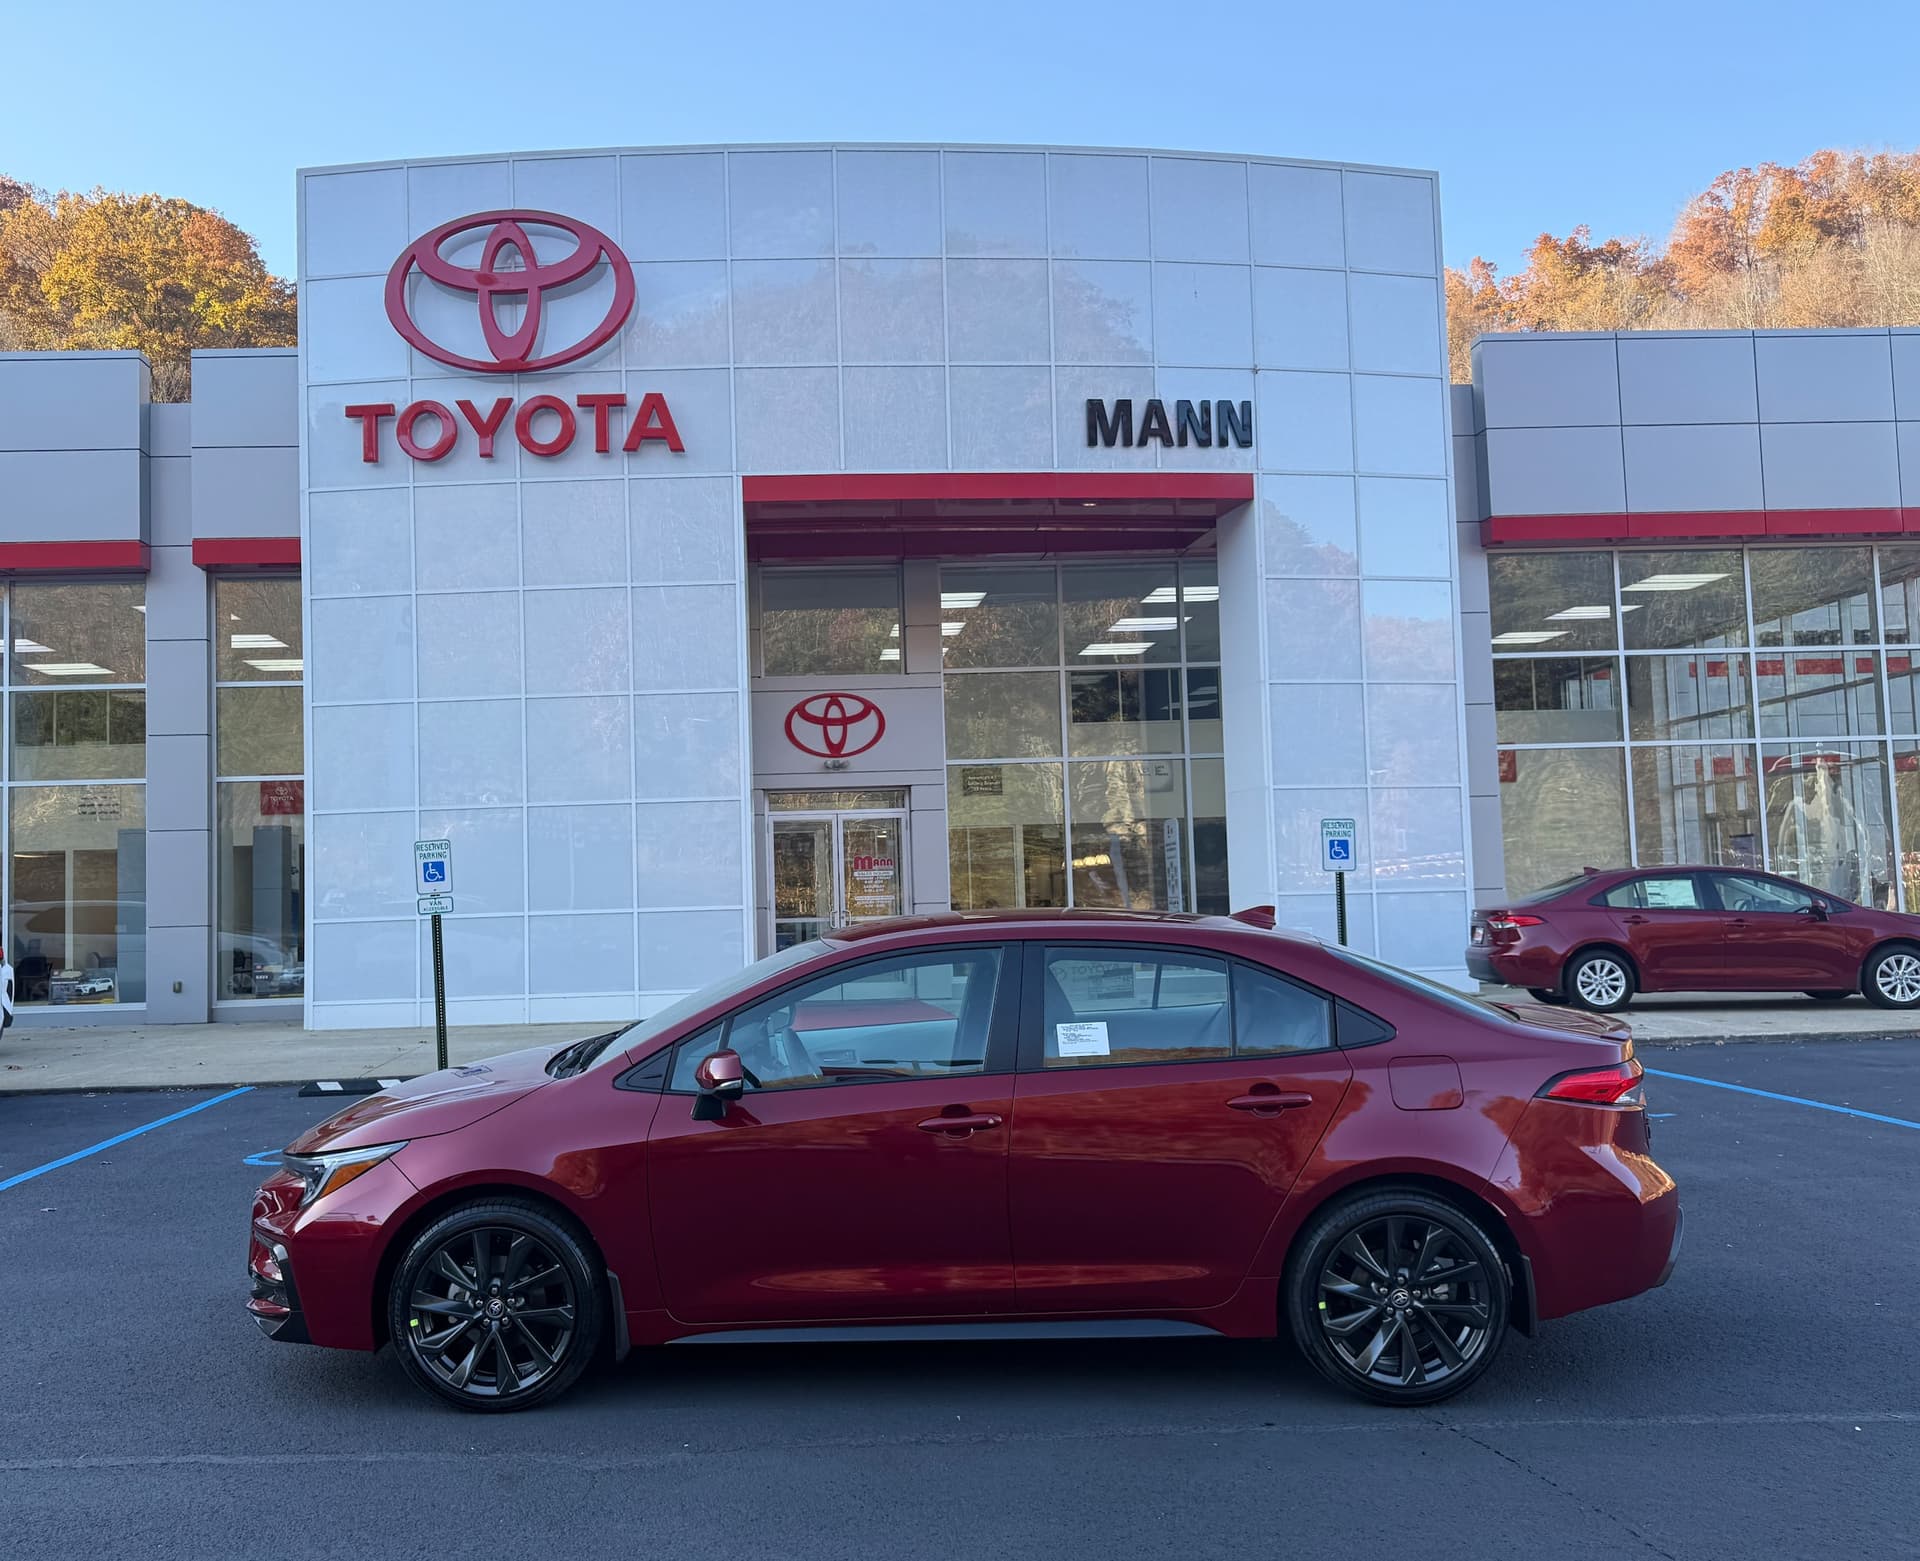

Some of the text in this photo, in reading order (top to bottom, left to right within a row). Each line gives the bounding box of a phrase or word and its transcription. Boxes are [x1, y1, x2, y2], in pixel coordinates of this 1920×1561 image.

[1086, 399, 1253, 447] MANN
[345, 393, 685, 463] TOYOTA
[1322, 821, 1353, 829] RESERVED
[1325, 830, 1352, 838] PARKING
[416, 842, 449, 852] RESERVED
[419, 851, 447, 860] PARKING
